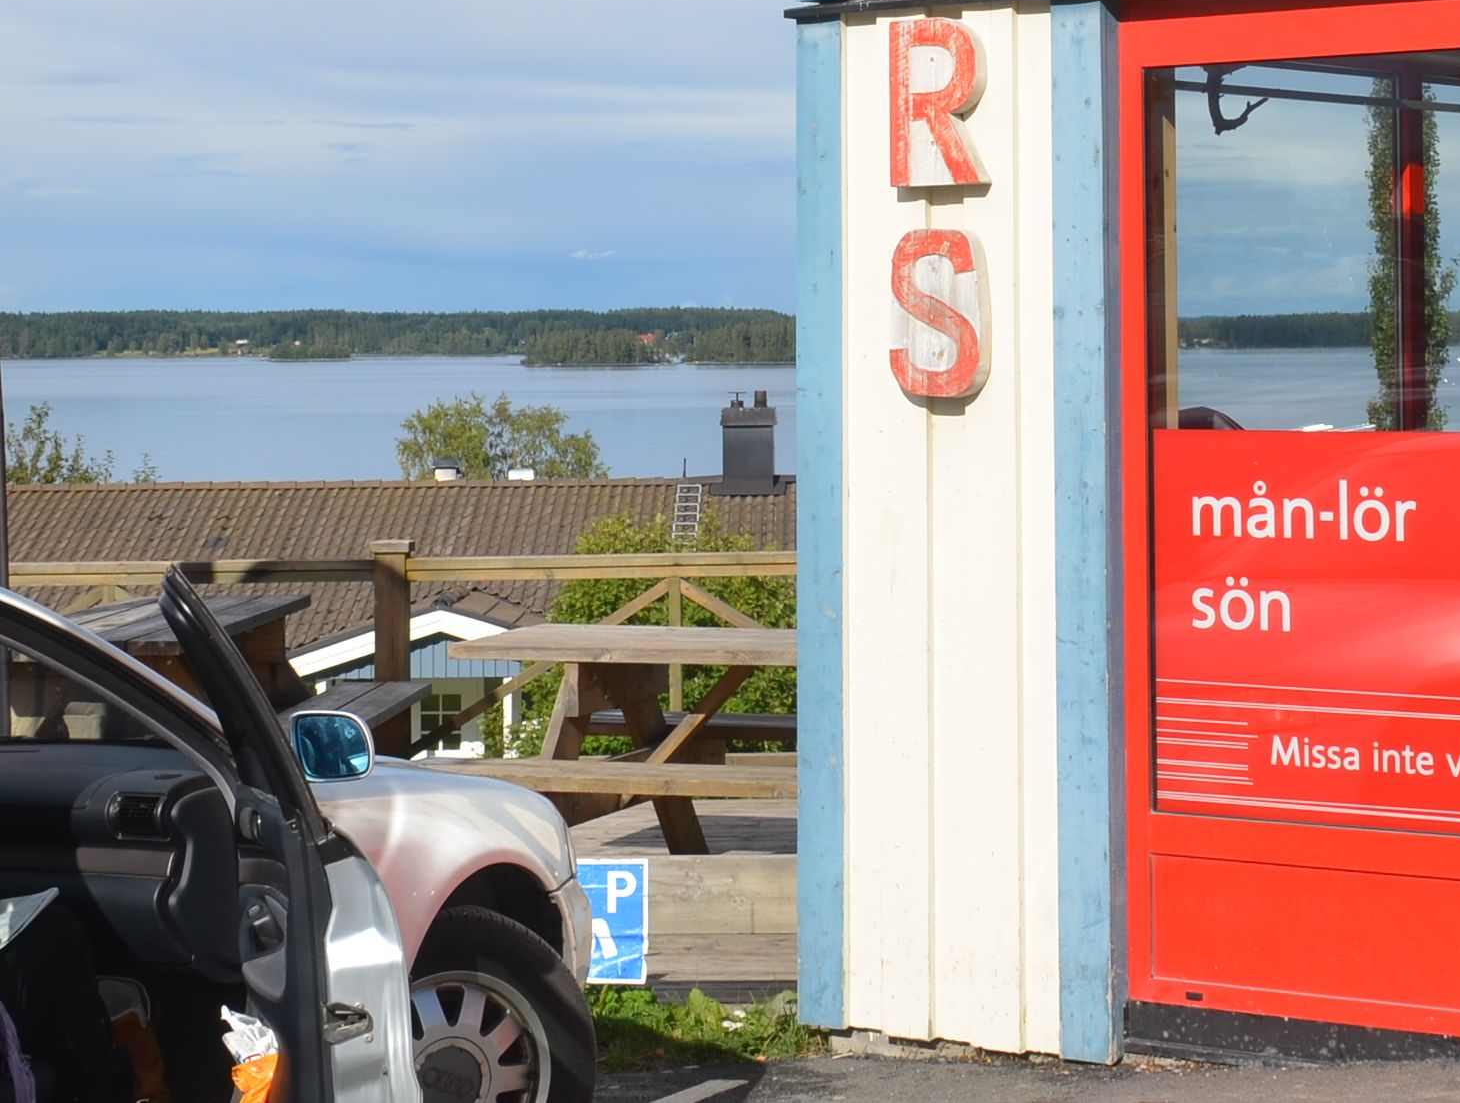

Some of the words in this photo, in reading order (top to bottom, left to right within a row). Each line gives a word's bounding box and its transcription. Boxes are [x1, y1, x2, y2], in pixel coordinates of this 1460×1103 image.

[1190, 479, 1417, 542] mån-lör
[1191, 576, 1292, 632] sön
[1270, 735, 1361, 771] Missa
[1372, 741, 1435, 777] inte
[606, 870, 638, 914] P
